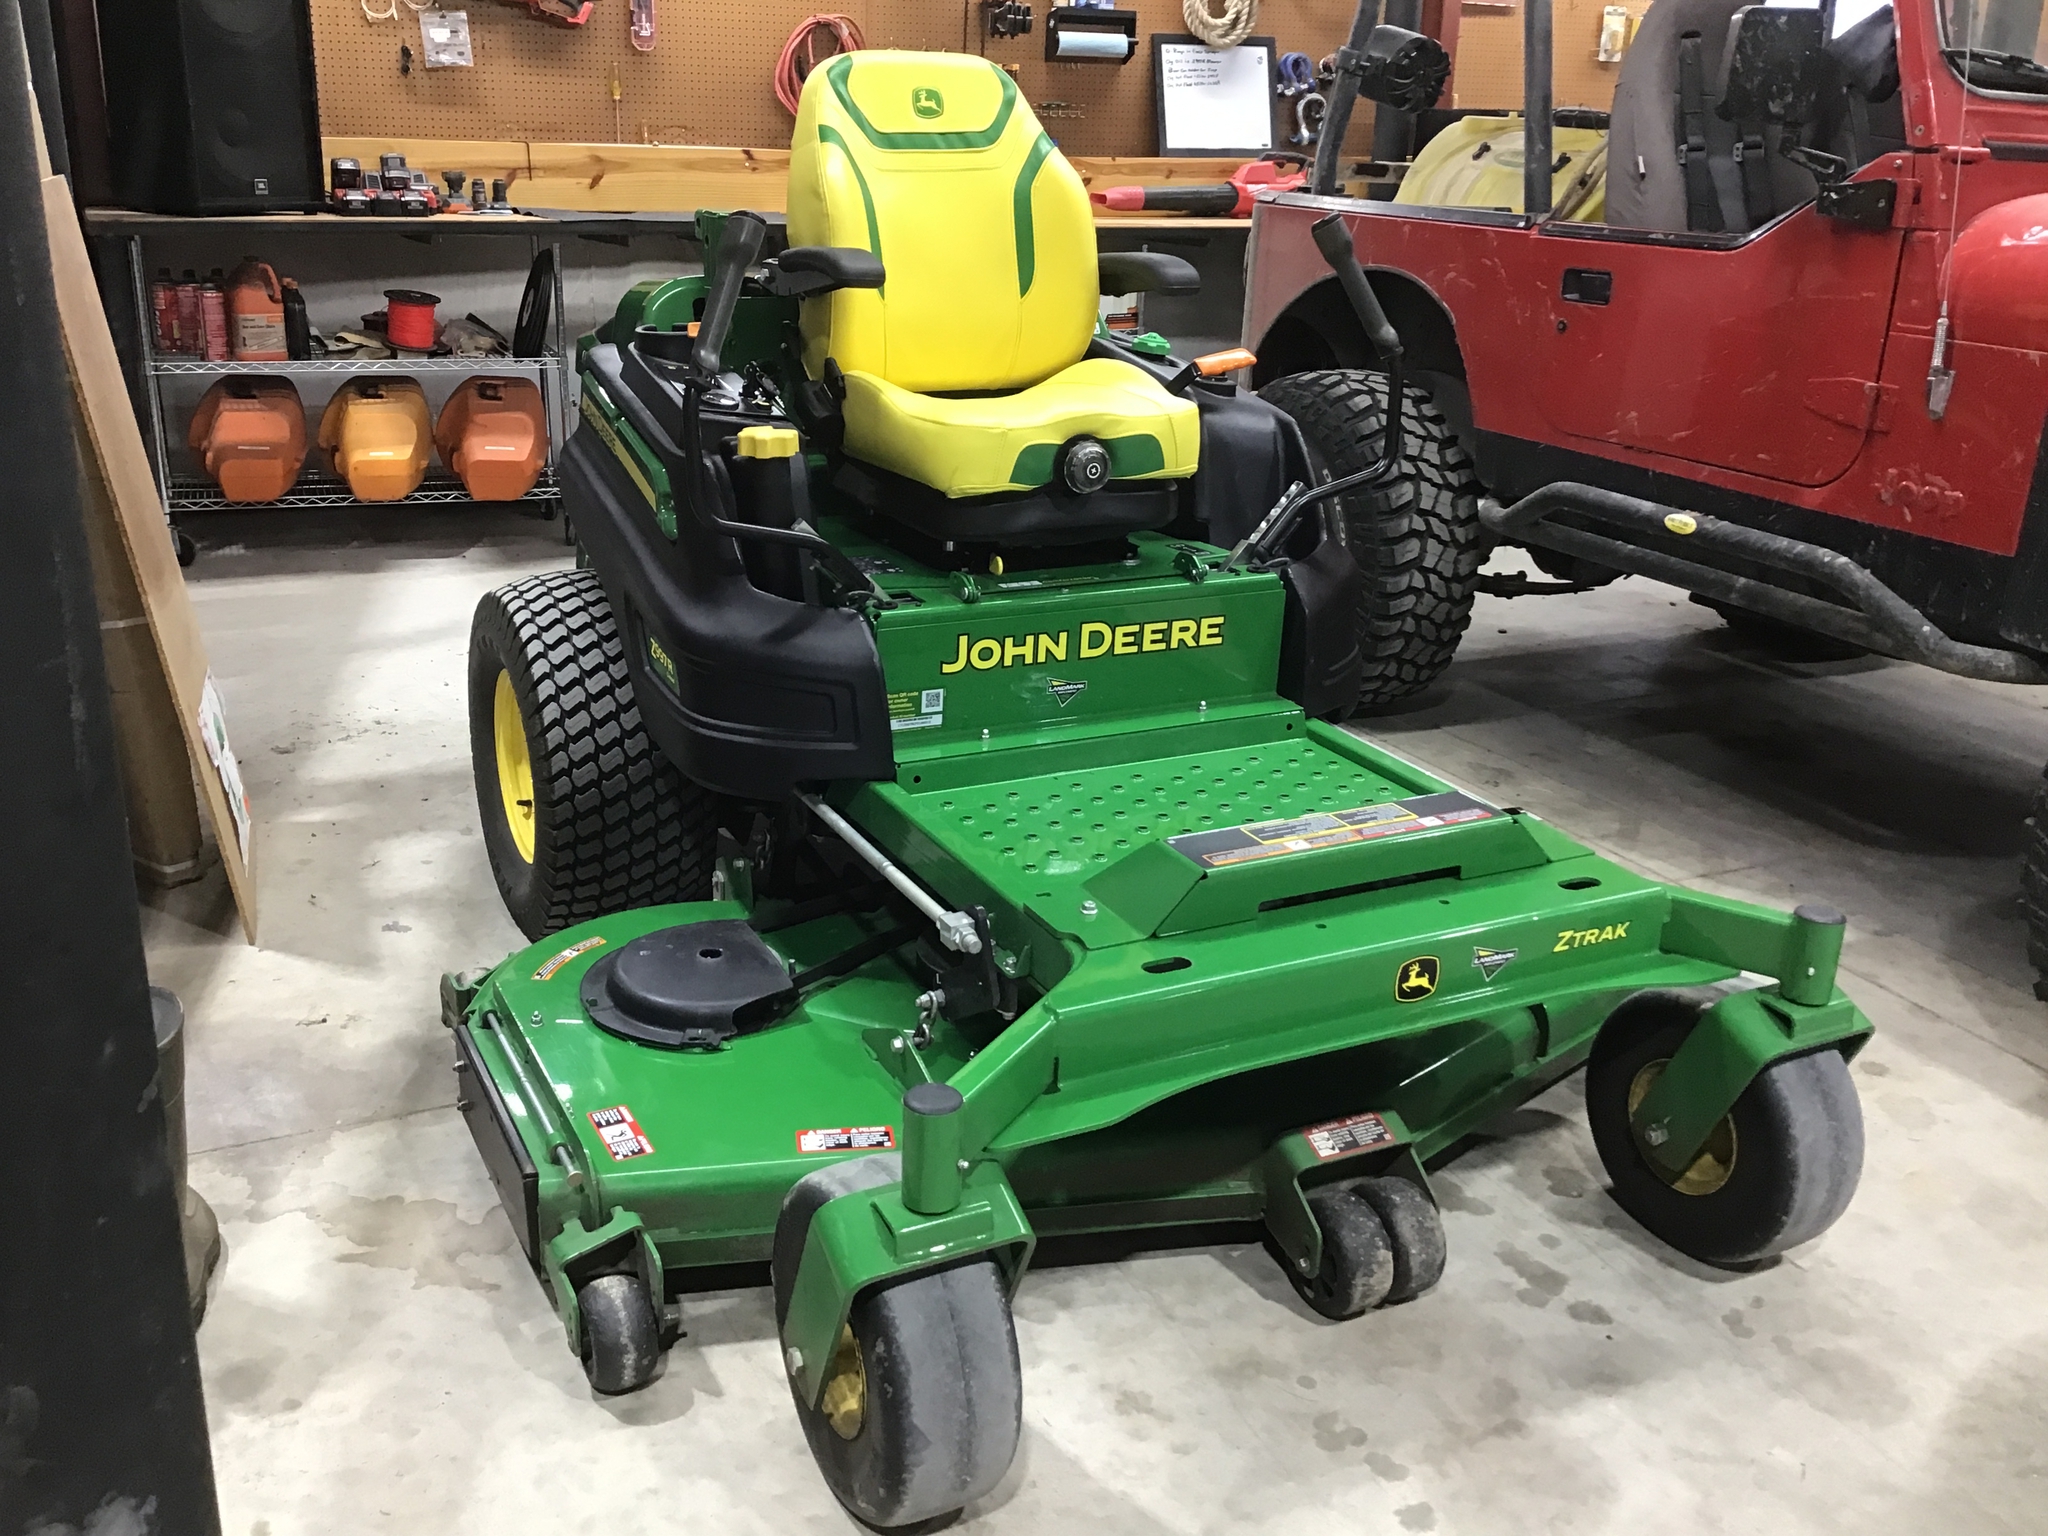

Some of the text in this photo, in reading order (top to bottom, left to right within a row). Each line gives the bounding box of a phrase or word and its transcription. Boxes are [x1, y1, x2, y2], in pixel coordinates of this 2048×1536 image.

[941, 616, 1225, 674] JOHN DEERE
[1553, 922, 1631, 953] ZTRAK
